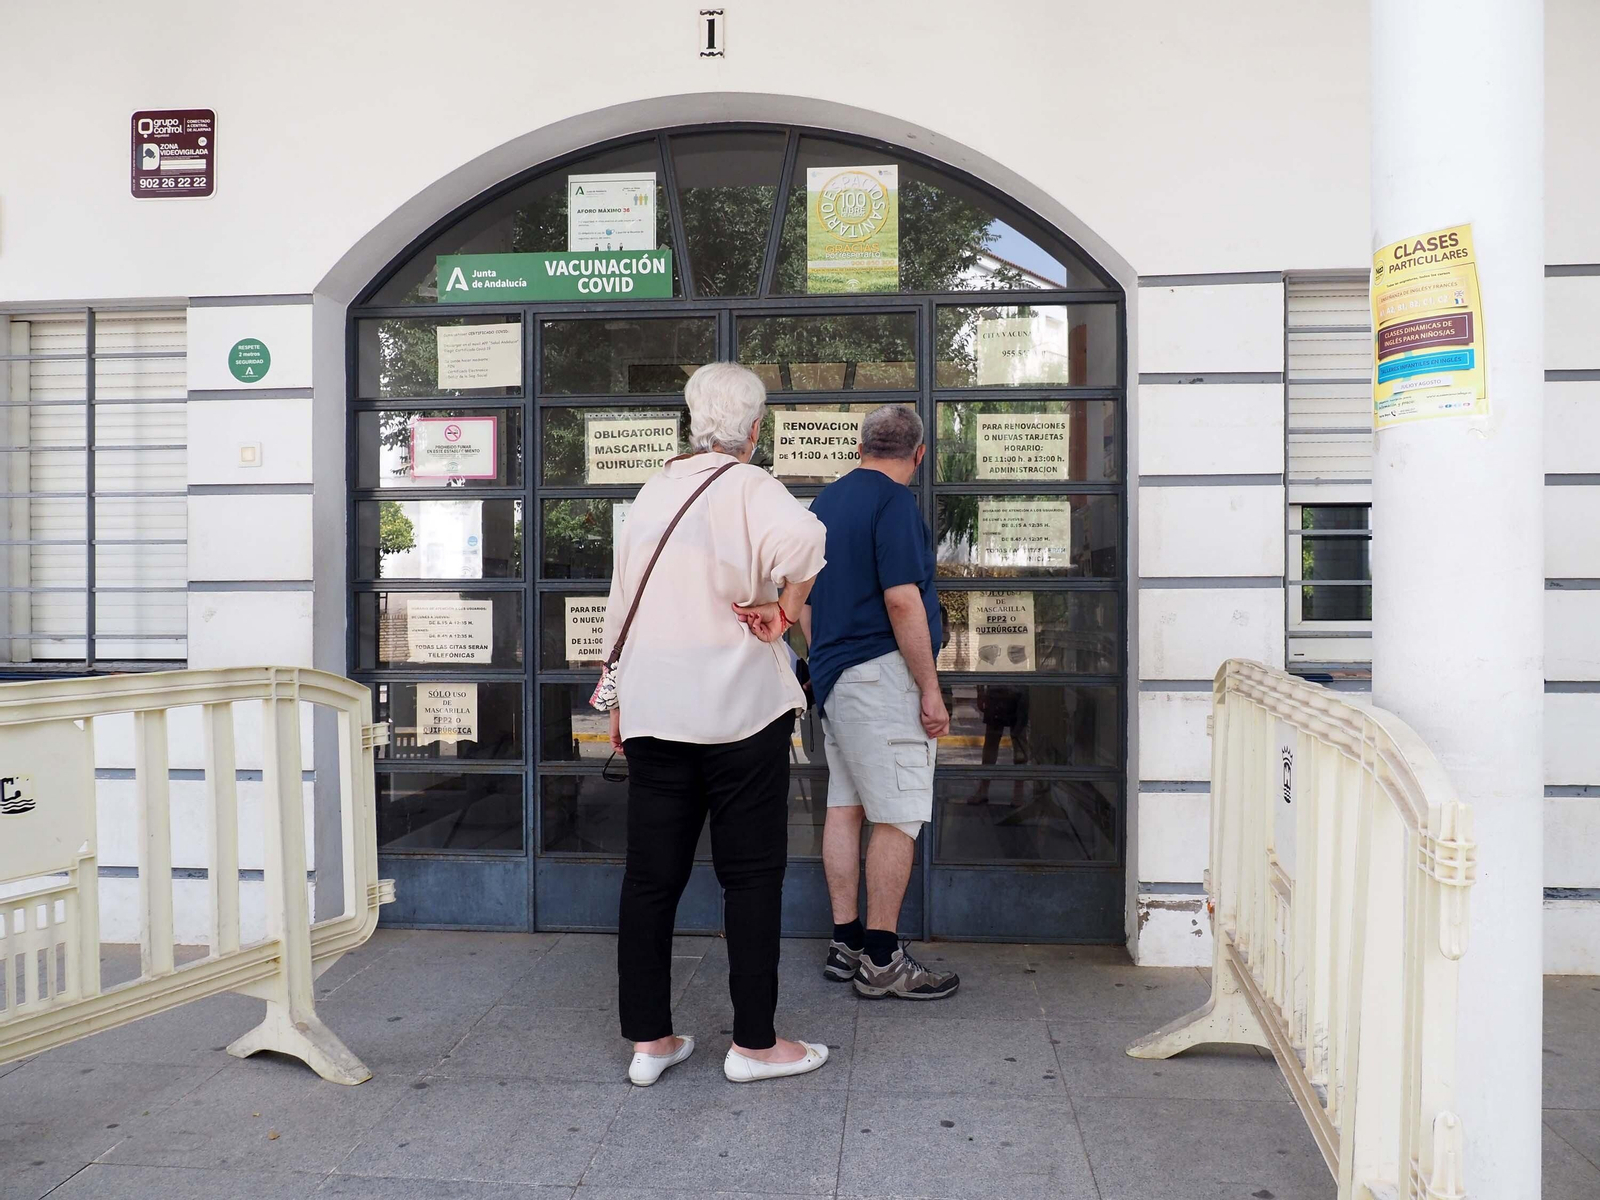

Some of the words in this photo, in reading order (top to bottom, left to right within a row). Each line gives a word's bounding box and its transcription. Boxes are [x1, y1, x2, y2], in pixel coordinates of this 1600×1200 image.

[154, 118, 178, 128] grupo
[154, 125, 182, 134] control
[140, 179, 159, 188] 902
[162, 178, 175, 187] 26
[178, 178, 191, 187] 22
[194, 177, 206, 187] 22
[841, 192, 866, 208] 100
[826, 243, 880, 252] GRACIAS
[1394, 232, 1459, 260] CLASES
[544, 254, 665, 276] VACUNACIÓN
[1388, 248, 1468, 274] PARTICULARES
[472, 270, 496, 278] Junta
[472, 280, 482, 288] de
[484, 278, 527, 288] Andalucía
[578, 278, 634, 293] COVID
[1384, 329, 1404, 339] CLASES
[1404, 322, 1441, 334] DINÁMICAS
[1384, 338, 1402, 347] INGLÉS
[1420, 329, 1455, 339] NIÑOS/AS
[1400, 361, 1430, 370] INFANTILES
[594, 427, 674, 439] OBLIGATORIO
[799, 437, 857, 445] TARJETAS
[595, 443, 674, 454] MASCARILLA
[596, 459, 664, 470] QUIRURGIC
[976, 625, 1028, 634] QUIRÚRGICA
[428, 689, 451, 697] SÓLO
[423, 726, 472, 734] QUIRÚRGICA
